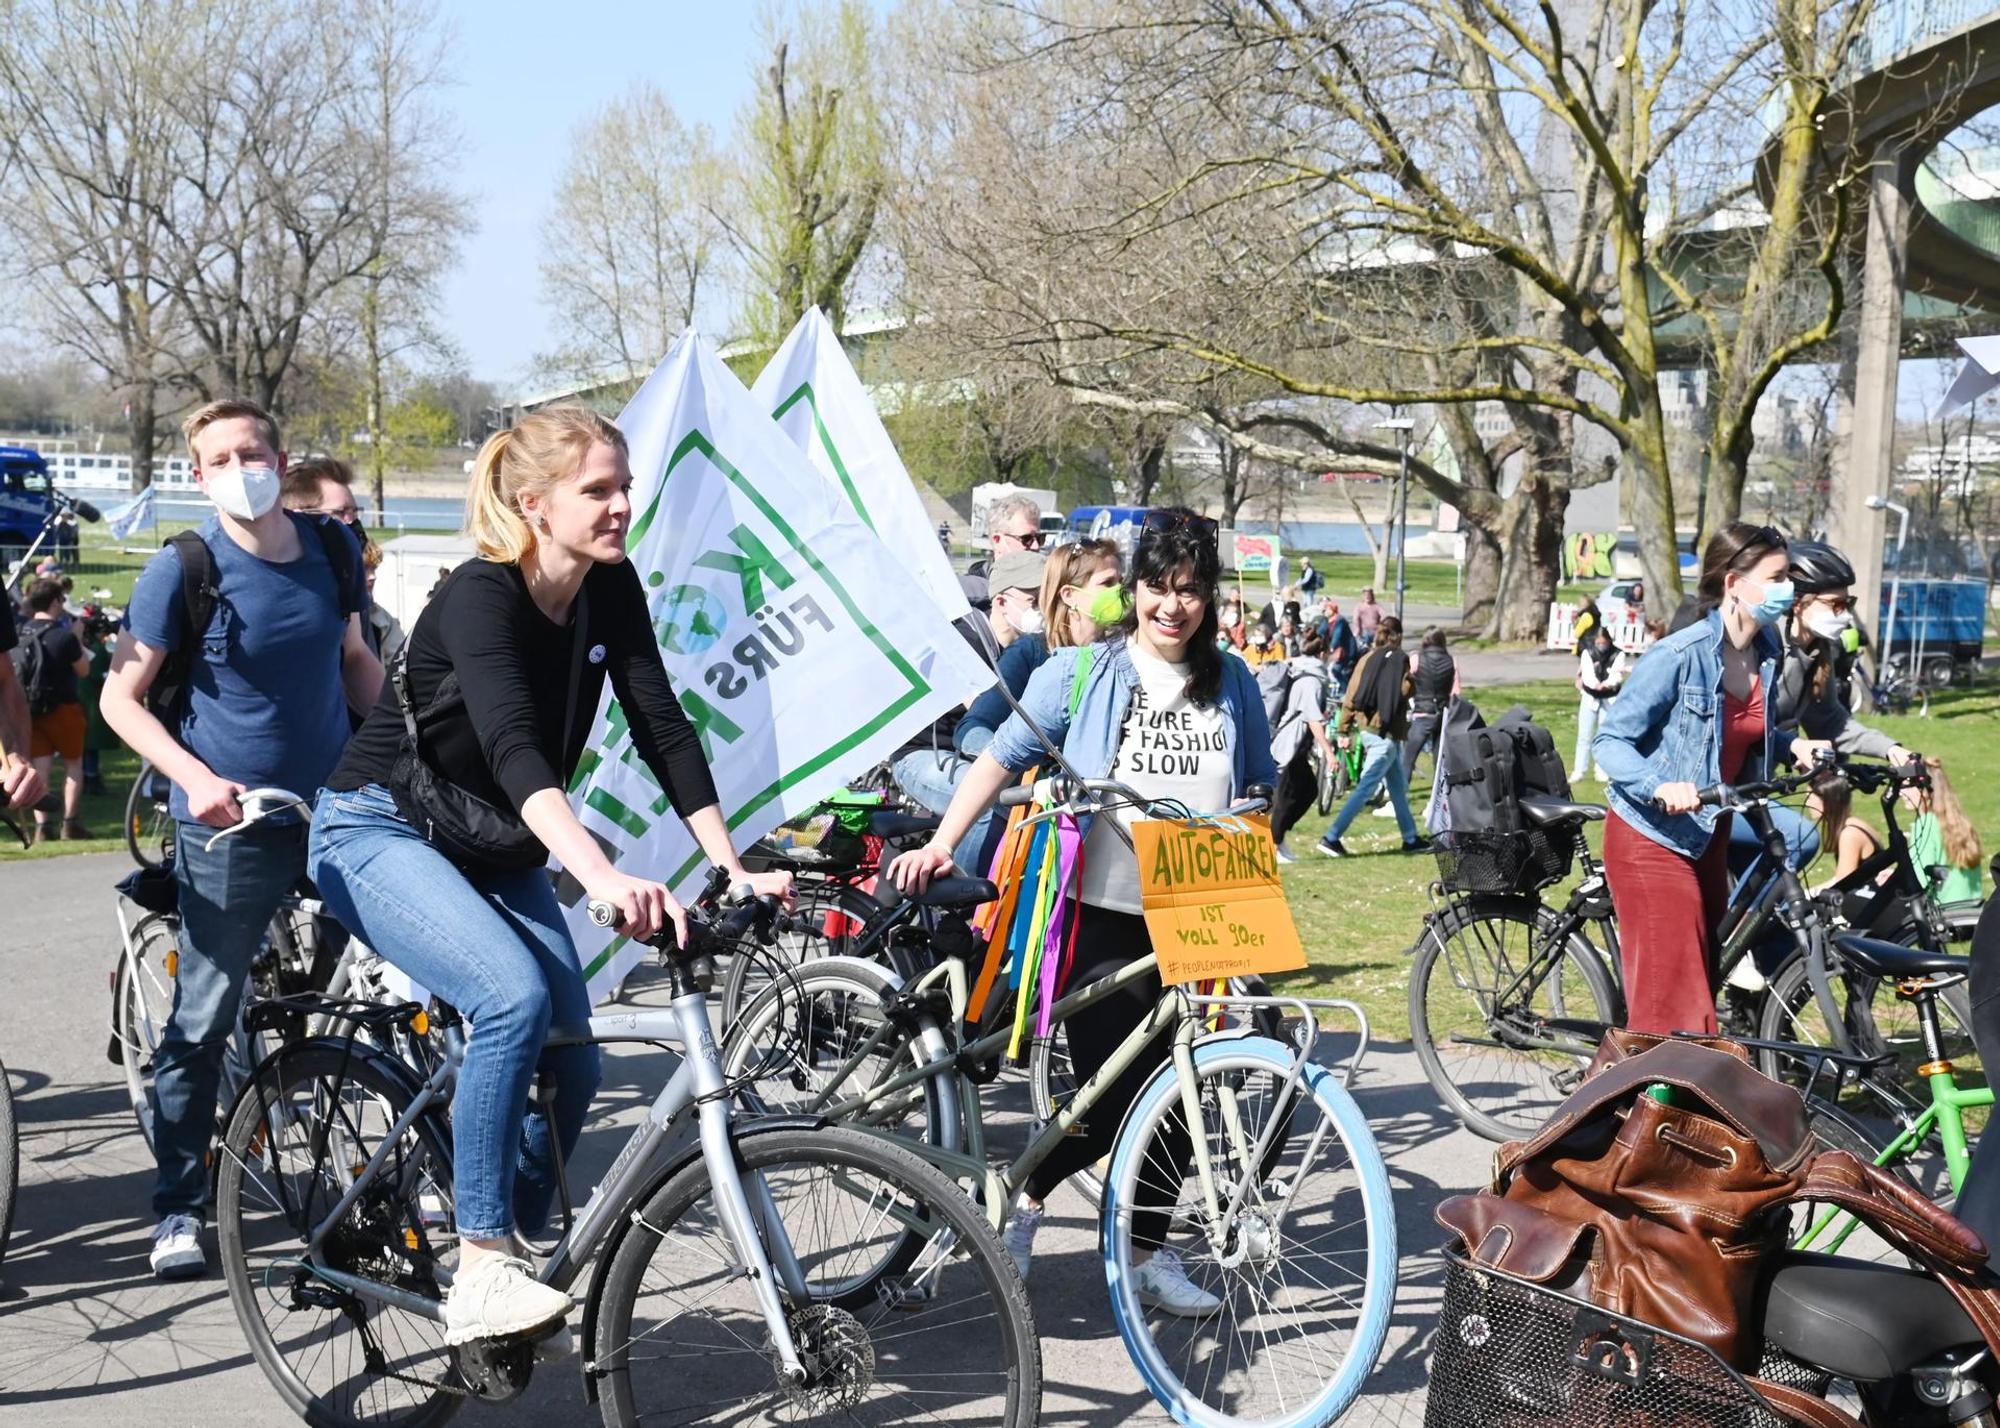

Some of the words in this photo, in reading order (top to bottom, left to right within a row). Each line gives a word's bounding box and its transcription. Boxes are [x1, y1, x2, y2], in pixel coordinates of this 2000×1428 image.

[1121, 710, 1193, 731] UTURE
[1141, 730, 1224, 751] FASHIO
[1131, 752, 1200, 775] SLOW
[1200, 904, 1226, 922] IST
[1176, 928, 1218, 946] VOLL
[1228, 922, 1266, 947] 90er
